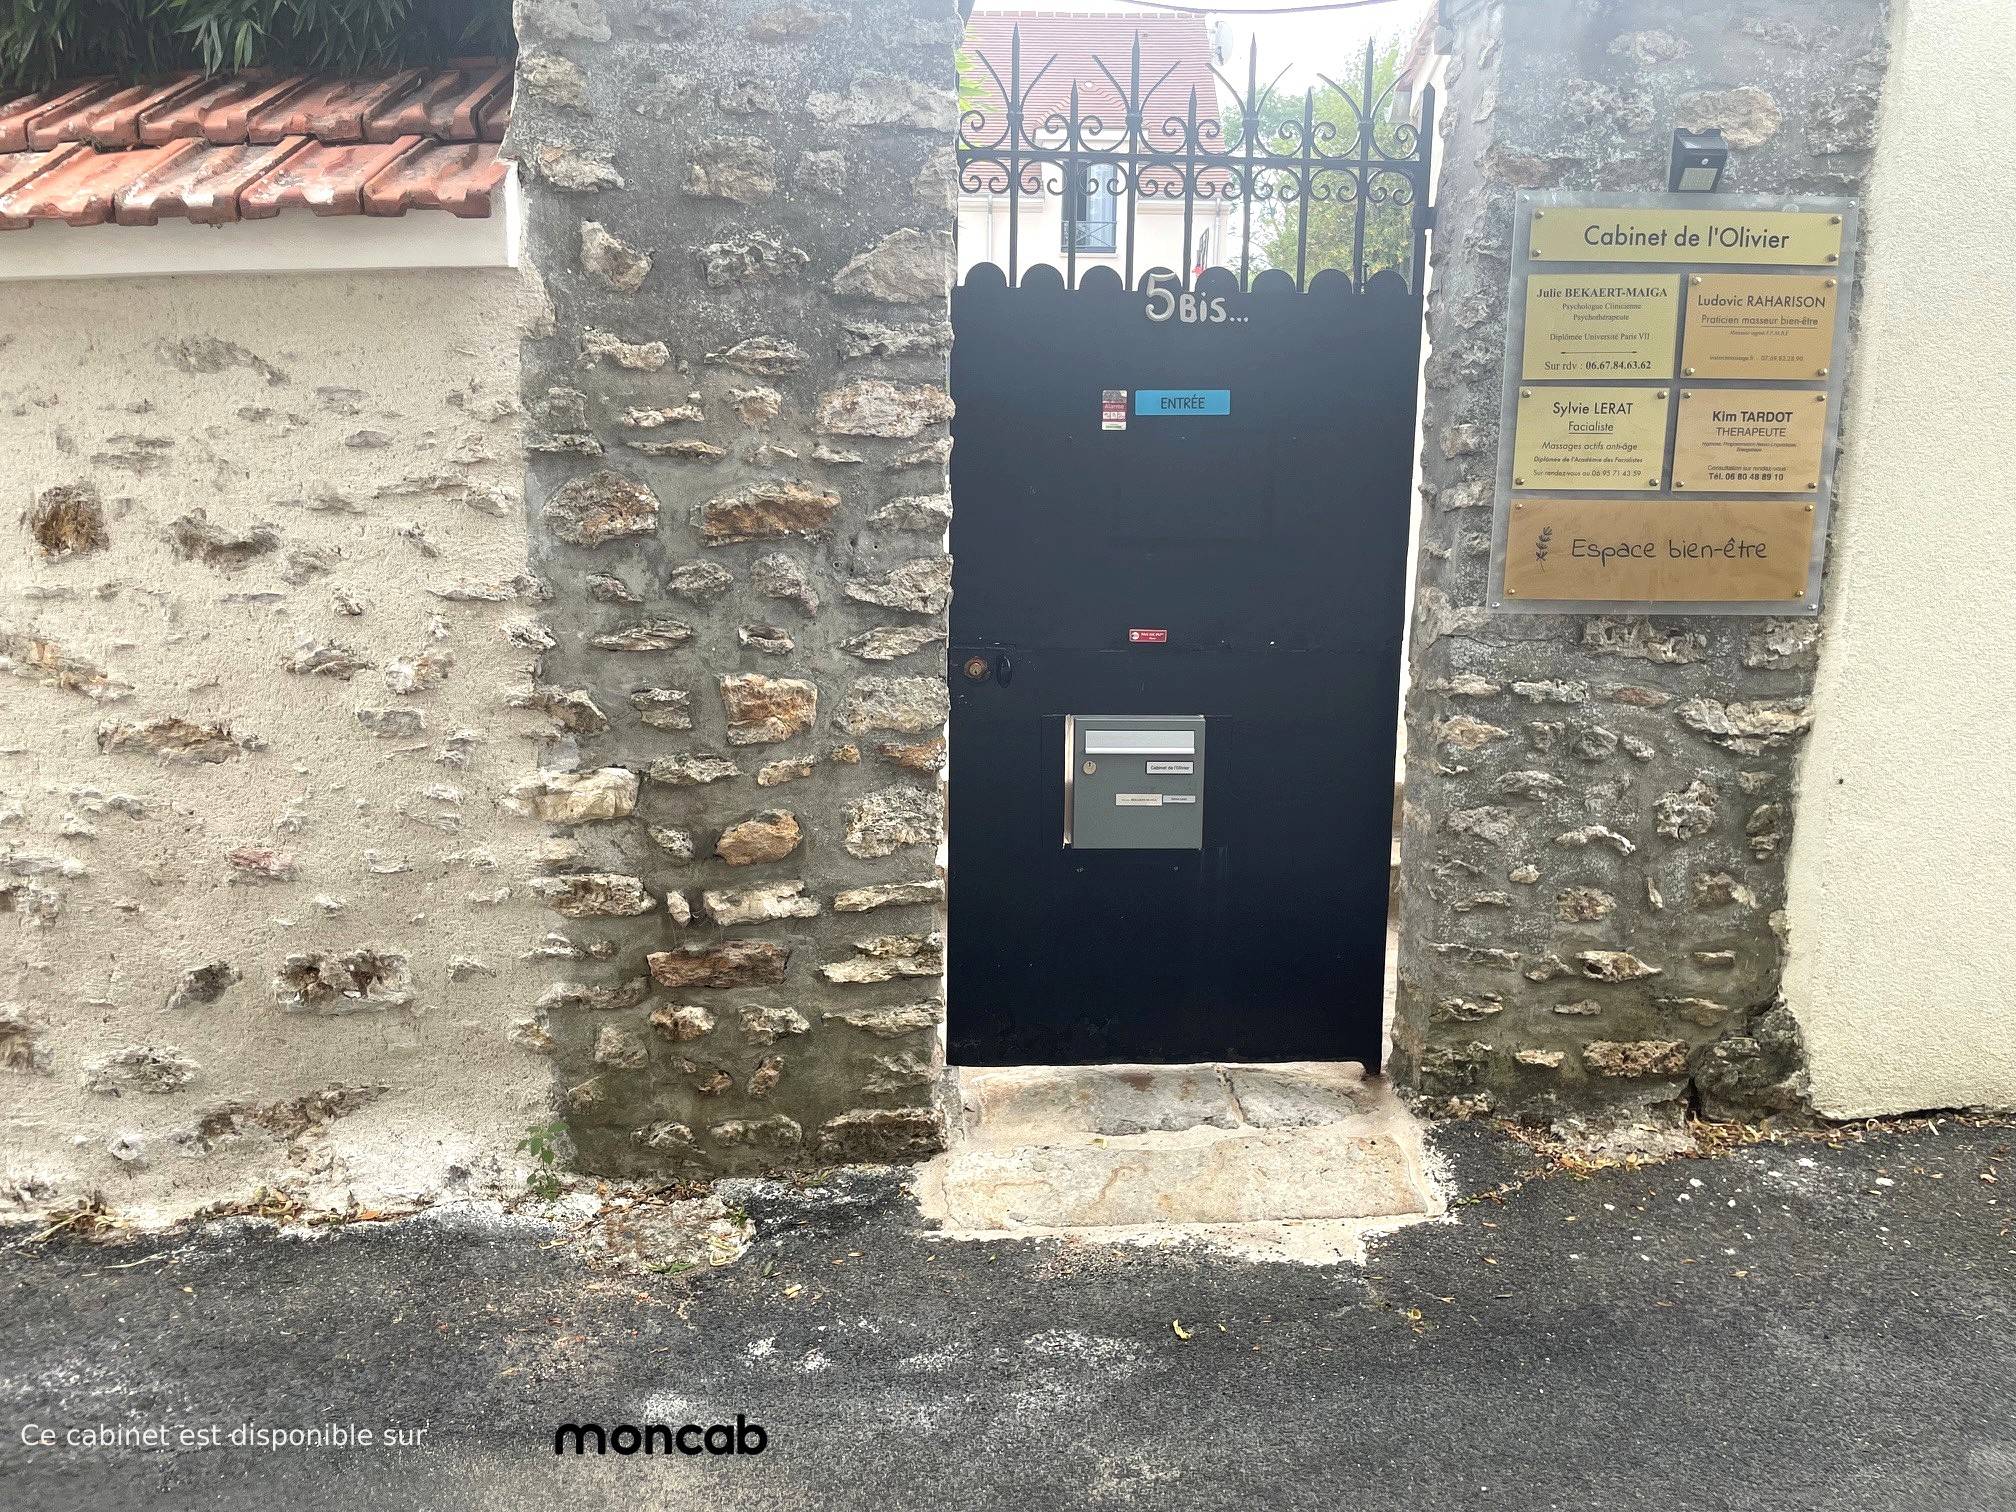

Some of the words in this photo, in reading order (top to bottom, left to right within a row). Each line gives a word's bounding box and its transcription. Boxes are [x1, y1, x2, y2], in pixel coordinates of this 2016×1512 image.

[1584, 224, 1667, 246] Cabinet
[1674, 225, 1700, 247] de
[1707, 225, 1790, 249] l'Olivier
[1145, 272, 1175, 322] 5
[1536, 288, 1562, 298] Julie
[1565, 287, 1668, 298] BEKAERT-MAIGA
[1697, 294, 1743, 307] Ludovic
[1746, 295, 1826, 308] RAHARISON
[1562, 303, 1603, 312] Psychologue
[1700, 314, 1739, 325] Praticien
[1741, 316, 1778, 325] masseur
[1780, 315, 1819, 326] bien-être
[1544, 361, 1561, 371] Sur
[1562, 360, 1577, 371] rdv
[1585, 360, 1652, 370] 06.67.84.63.62
[1160, 393, 1206, 410] ENTRÉE
[1552, 401, 1590, 418] Sylvie
[1594, 402, 1633, 415] LERAT
[1712, 411, 1737, 422] Kim
[1740, 411, 1793, 423] TARDOT
[1568, 421, 1614, 431] Facialiste
[1716, 427, 1787, 437] THERAPEUTE
[1541, 442, 1581, 452] Massages
[1583, 442, 1604, 450] actifs
[1533, 469, 1544, 477] Sur
[1602, 469, 1611, 477] 95
[1622, 469, 1631, 477] 43
[1632, 469, 1642, 477] 59
[1749, 473, 1760, 481] 48
[1571, 539, 1657, 568] Espace
[1668, 537, 1768, 559] bien-être
